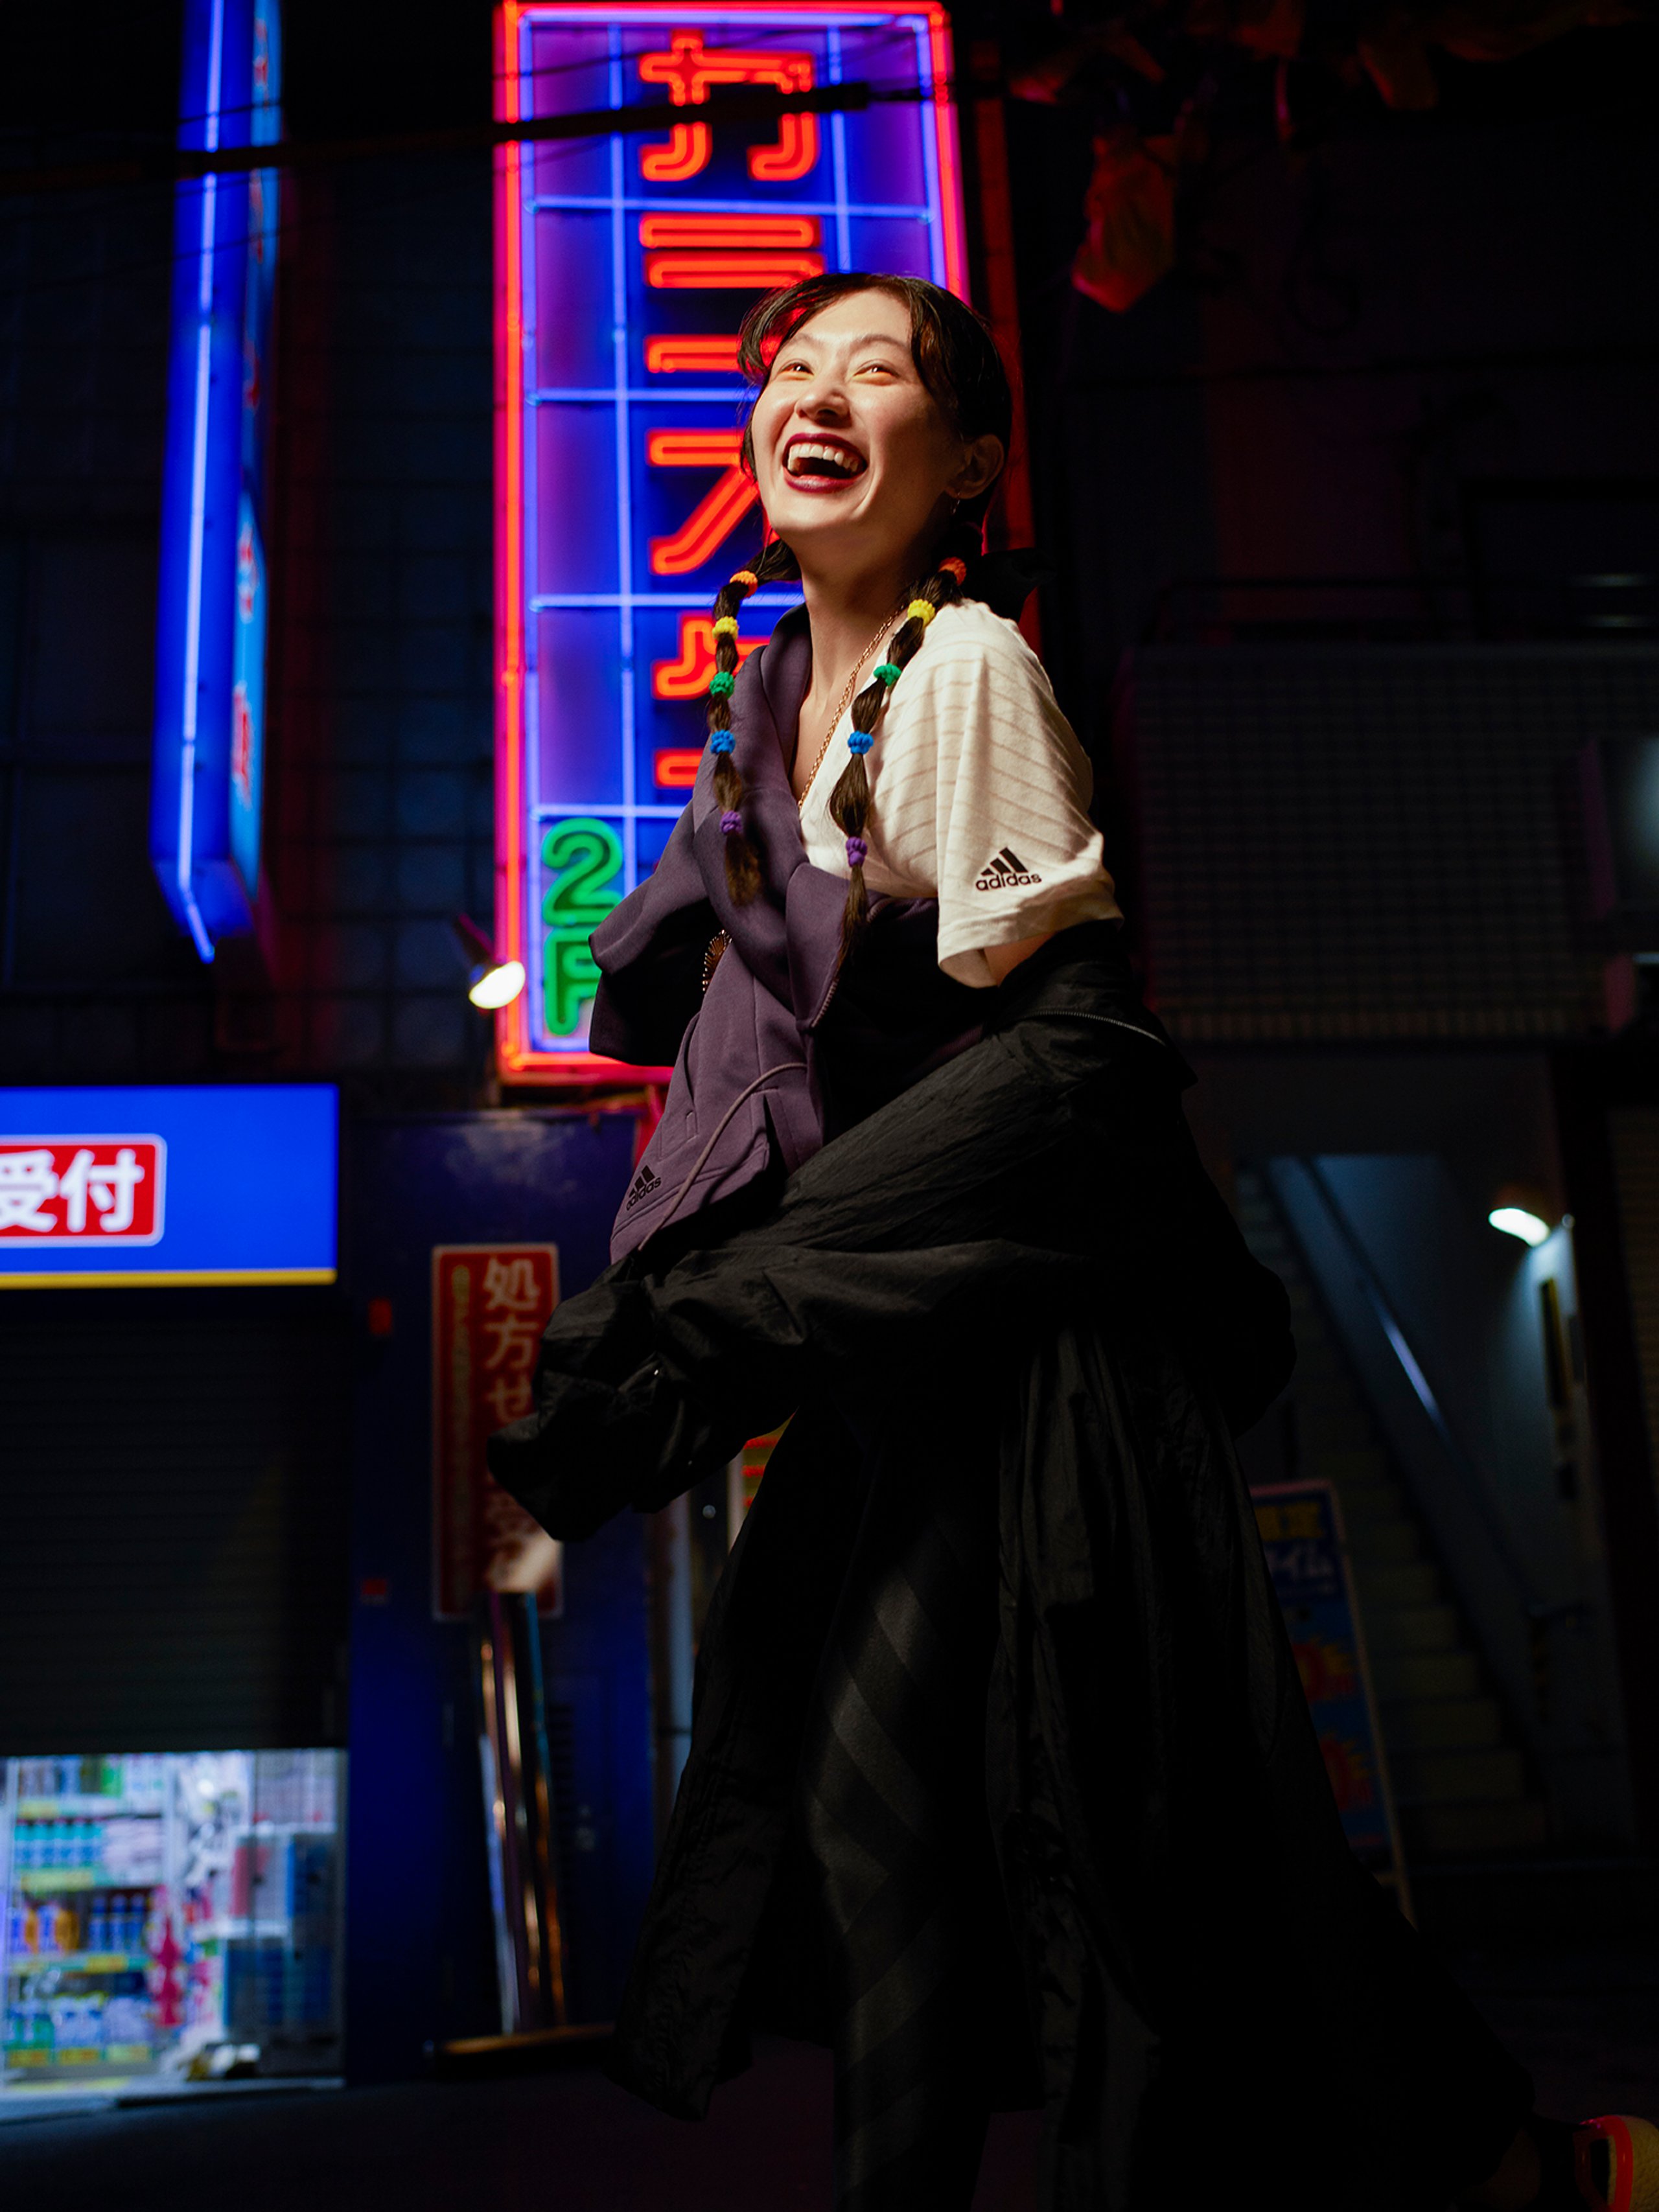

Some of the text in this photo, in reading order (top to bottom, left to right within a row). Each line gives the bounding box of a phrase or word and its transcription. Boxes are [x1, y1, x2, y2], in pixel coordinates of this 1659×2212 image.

[975, 873, 1042, 891] adidas
[0, 1149, 145, 1232] 受付
[627, 1177, 662, 1211] adidas
